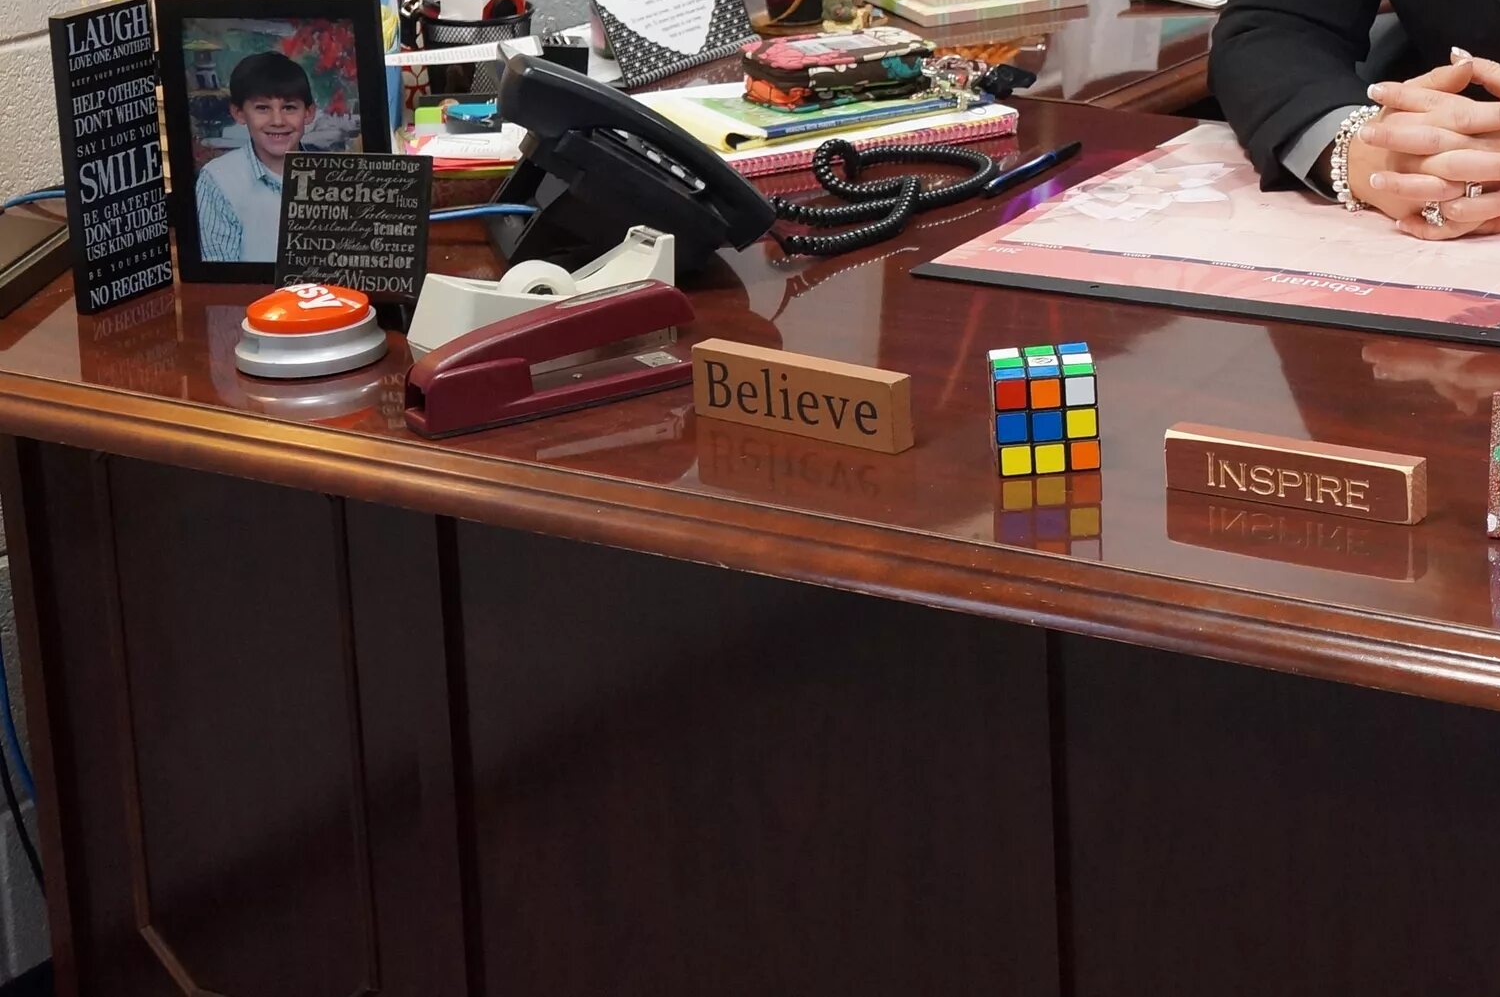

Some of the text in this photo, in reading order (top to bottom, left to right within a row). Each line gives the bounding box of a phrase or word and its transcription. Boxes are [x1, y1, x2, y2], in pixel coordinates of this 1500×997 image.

[66, 3, 150, 56] LAUGH
[69, 37, 152, 72] LOVE ONE ANOTHER
[72, 75, 156, 116] HELP OTHERS
[74, 95, 158, 138] DON'T WHINE
[77, 121, 159, 157] SAY I LOVE YOU
[79, 140, 163, 204] SMILE
[291, 157, 420, 173] GIVING Knowledge
[325, 169, 418, 190] Challenging
[290, 169, 399, 203] Teacher
[83, 187, 166, 227] BE GRATEFUL
[85, 201, 167, 246] DON'T JUDGE
[288, 201, 417, 221] DEVOTION Patience
[86, 220, 168, 262] USE KIND WORDS
[285, 232, 336, 251] KIND
[370, 237, 415, 253] Grace
[287, 219, 417, 238] Understanding Tender
[88, 243, 169, 281] BE YOURSELF
[327, 252, 415, 269] Counselor
[90, 260, 172, 309] NO REGRETS
[345, 269, 413, 293] WISDOM
[1262, 274, 1375, 297] February
[704, 360, 878, 436] Believe
[1206, 452, 1370, 512] INSPIRE
